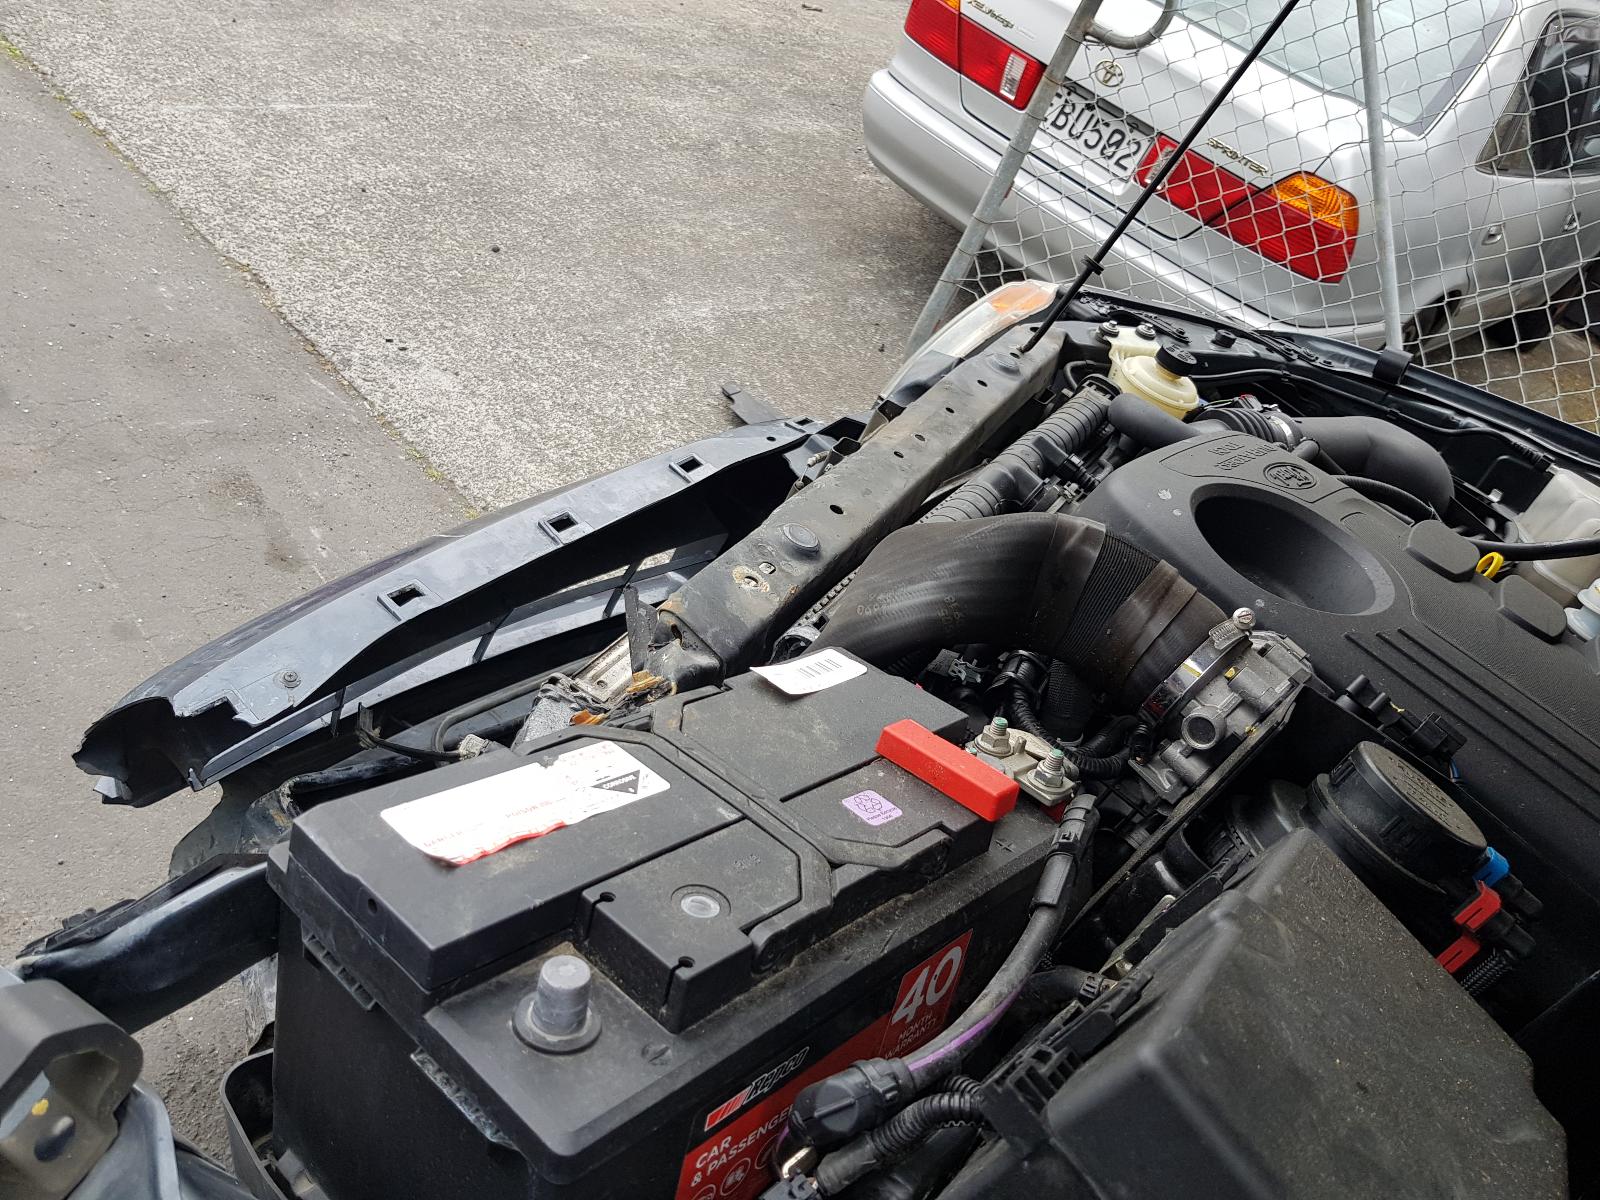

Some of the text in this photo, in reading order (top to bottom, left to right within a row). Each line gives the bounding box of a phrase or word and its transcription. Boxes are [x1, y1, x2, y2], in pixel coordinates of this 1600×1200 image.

[1208, 137, 1268, 176] SPRINTER
[891, 945, 962, 1026] 40
[885, 1016, 937, 1060] WARRANTY
[898, 1010, 933, 1045] MONTH
[696, 1135, 733, 1169] CAR
[691, 1171, 702, 1188] &
